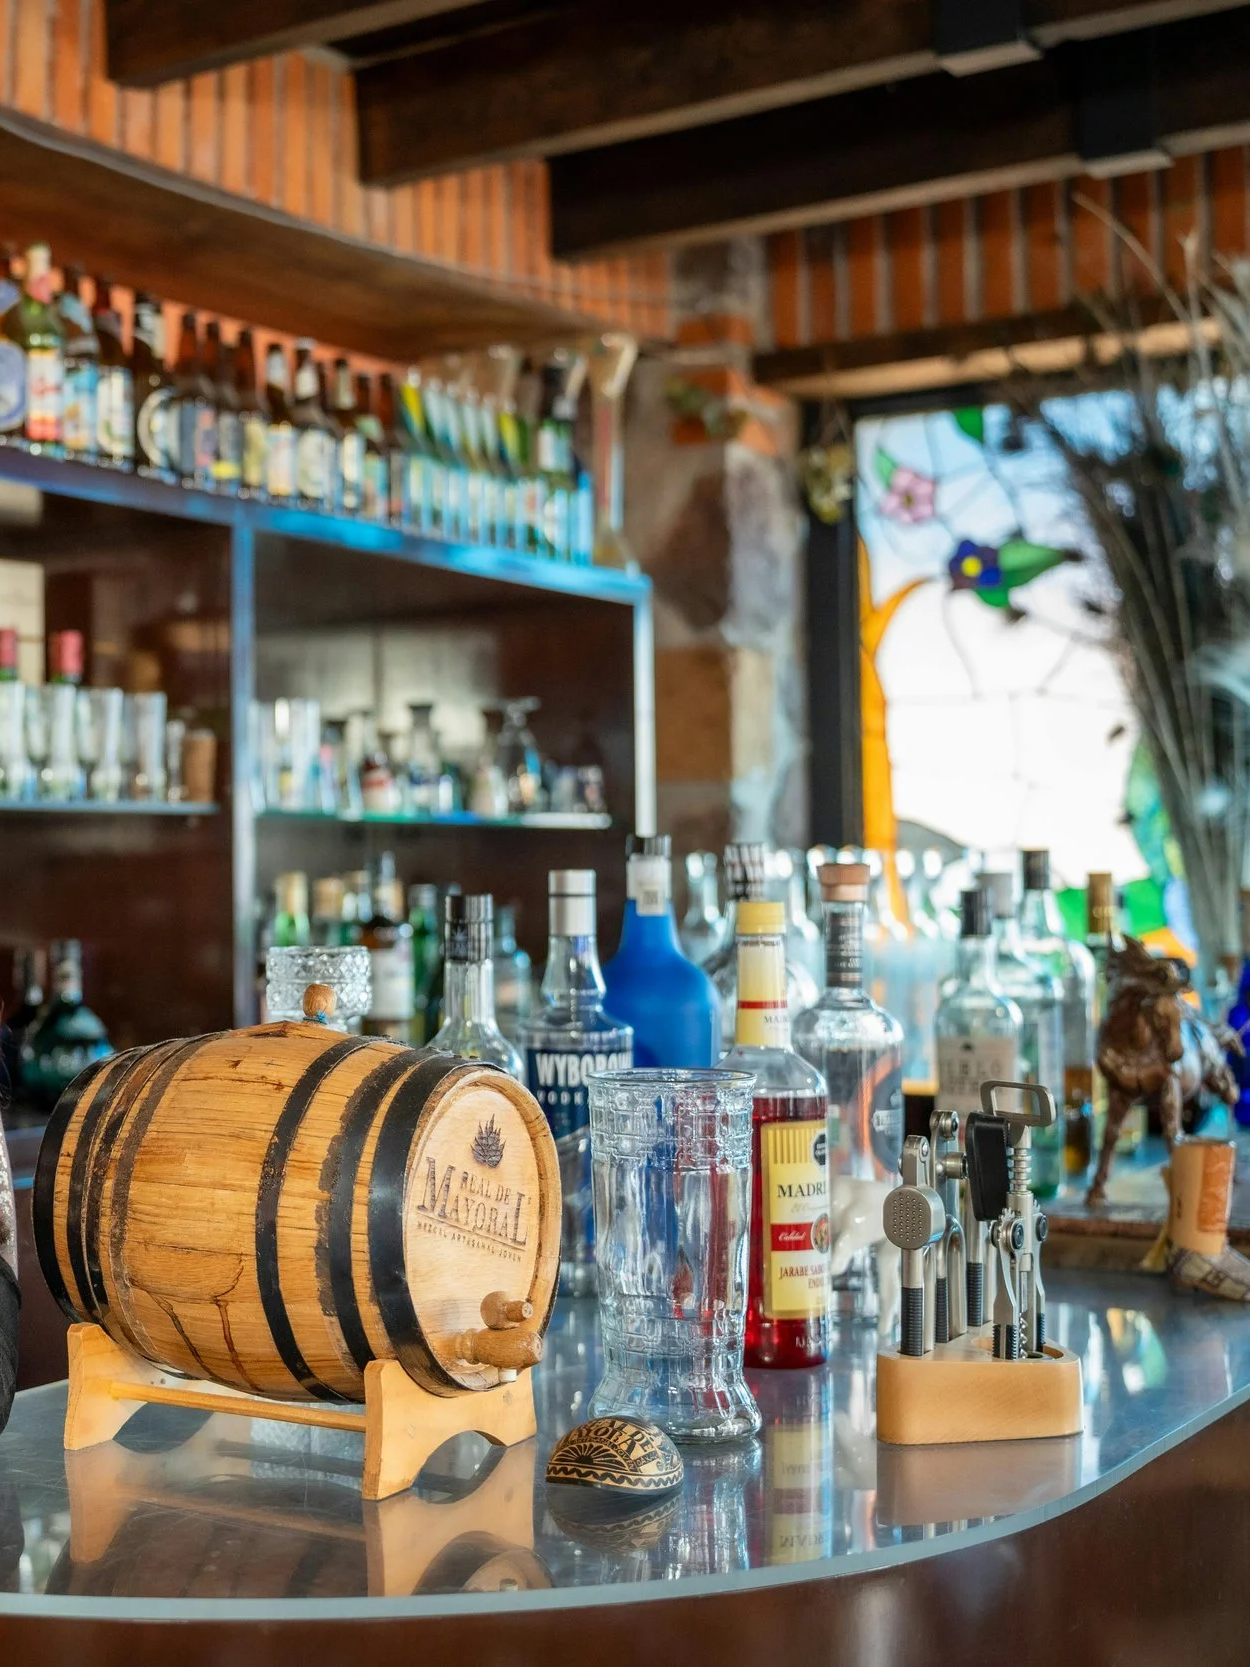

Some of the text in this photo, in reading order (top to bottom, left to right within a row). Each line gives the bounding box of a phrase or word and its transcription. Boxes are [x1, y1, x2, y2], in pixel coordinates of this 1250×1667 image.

[536, 1089, 588, 1106] VODK
[417, 1156, 527, 1246] MAYORAL
[460, 1171, 511, 1205] REAL DE
[417, 1221, 522, 1263] MEZCAL ARTESANAL JOVEN
[778, 1265, 808, 1279] JARABE
[629, 1431, 654, 1452] DE
